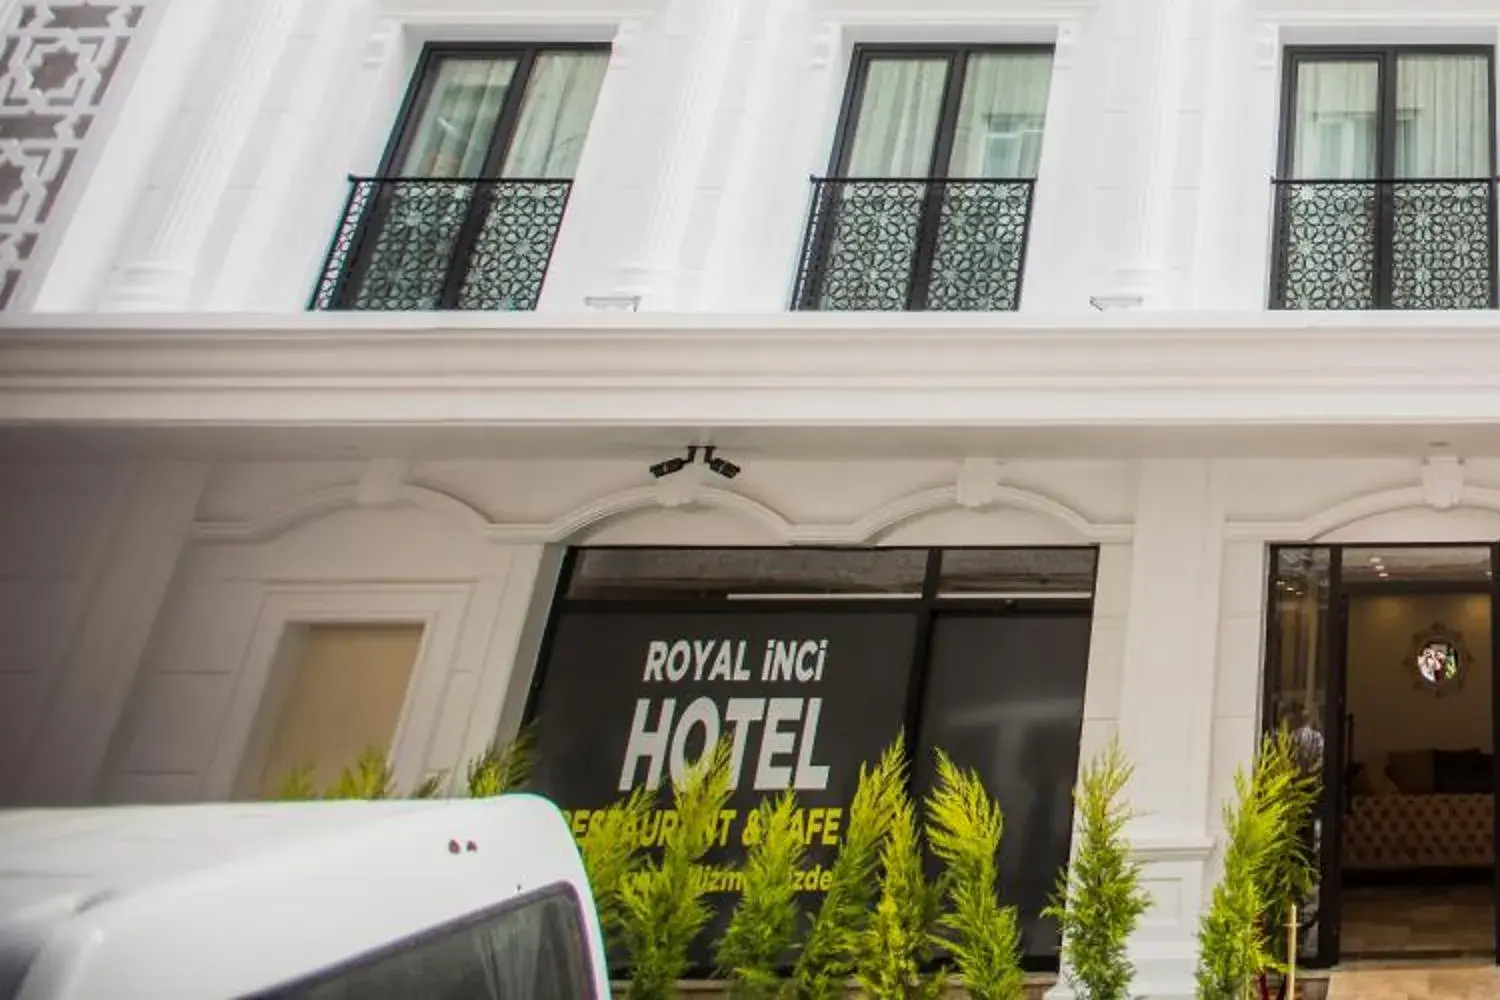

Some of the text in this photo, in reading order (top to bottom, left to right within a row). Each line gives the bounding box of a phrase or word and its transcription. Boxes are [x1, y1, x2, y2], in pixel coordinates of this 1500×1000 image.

[643, 639, 751, 682] ROYAL
[618, 696, 831, 792] HOTEL
[563, 808, 737, 847] ESAURNT
[773, 807, 843, 845] AFE
